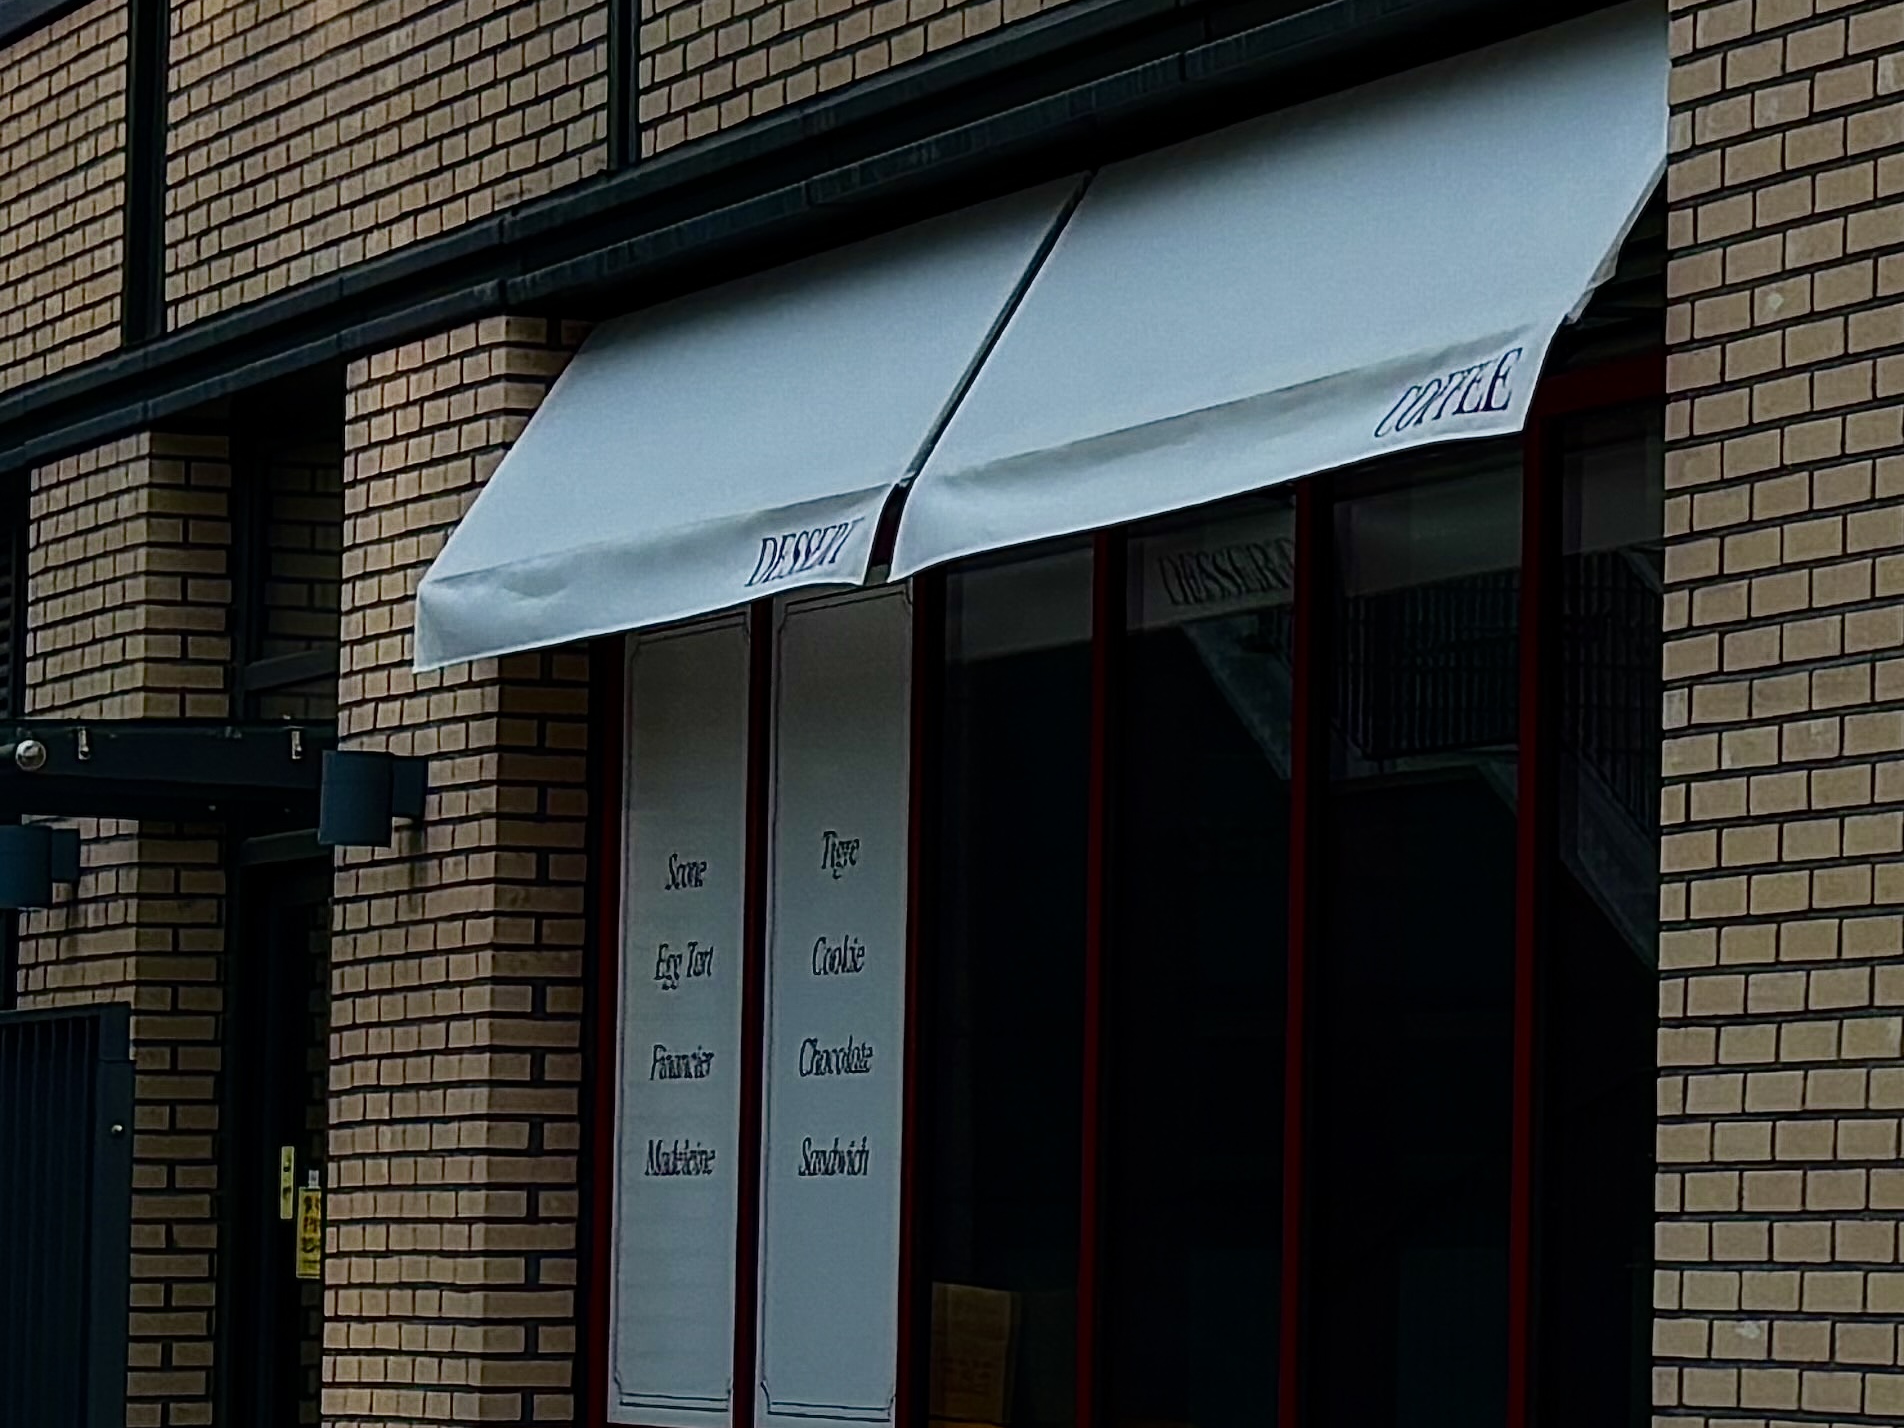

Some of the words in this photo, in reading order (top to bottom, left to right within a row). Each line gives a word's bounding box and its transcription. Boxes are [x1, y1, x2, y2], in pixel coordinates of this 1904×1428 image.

[1373, 346, 1524, 440] COFFEE
[749, 516, 866, 589] DESSERT
[821, 830, 860, 879] Tigre
[812, 935, 866, 976] Cookie
[799, 1035, 874, 1078] Chocolate
[798, 1135, 870, 1177] Sandwich
